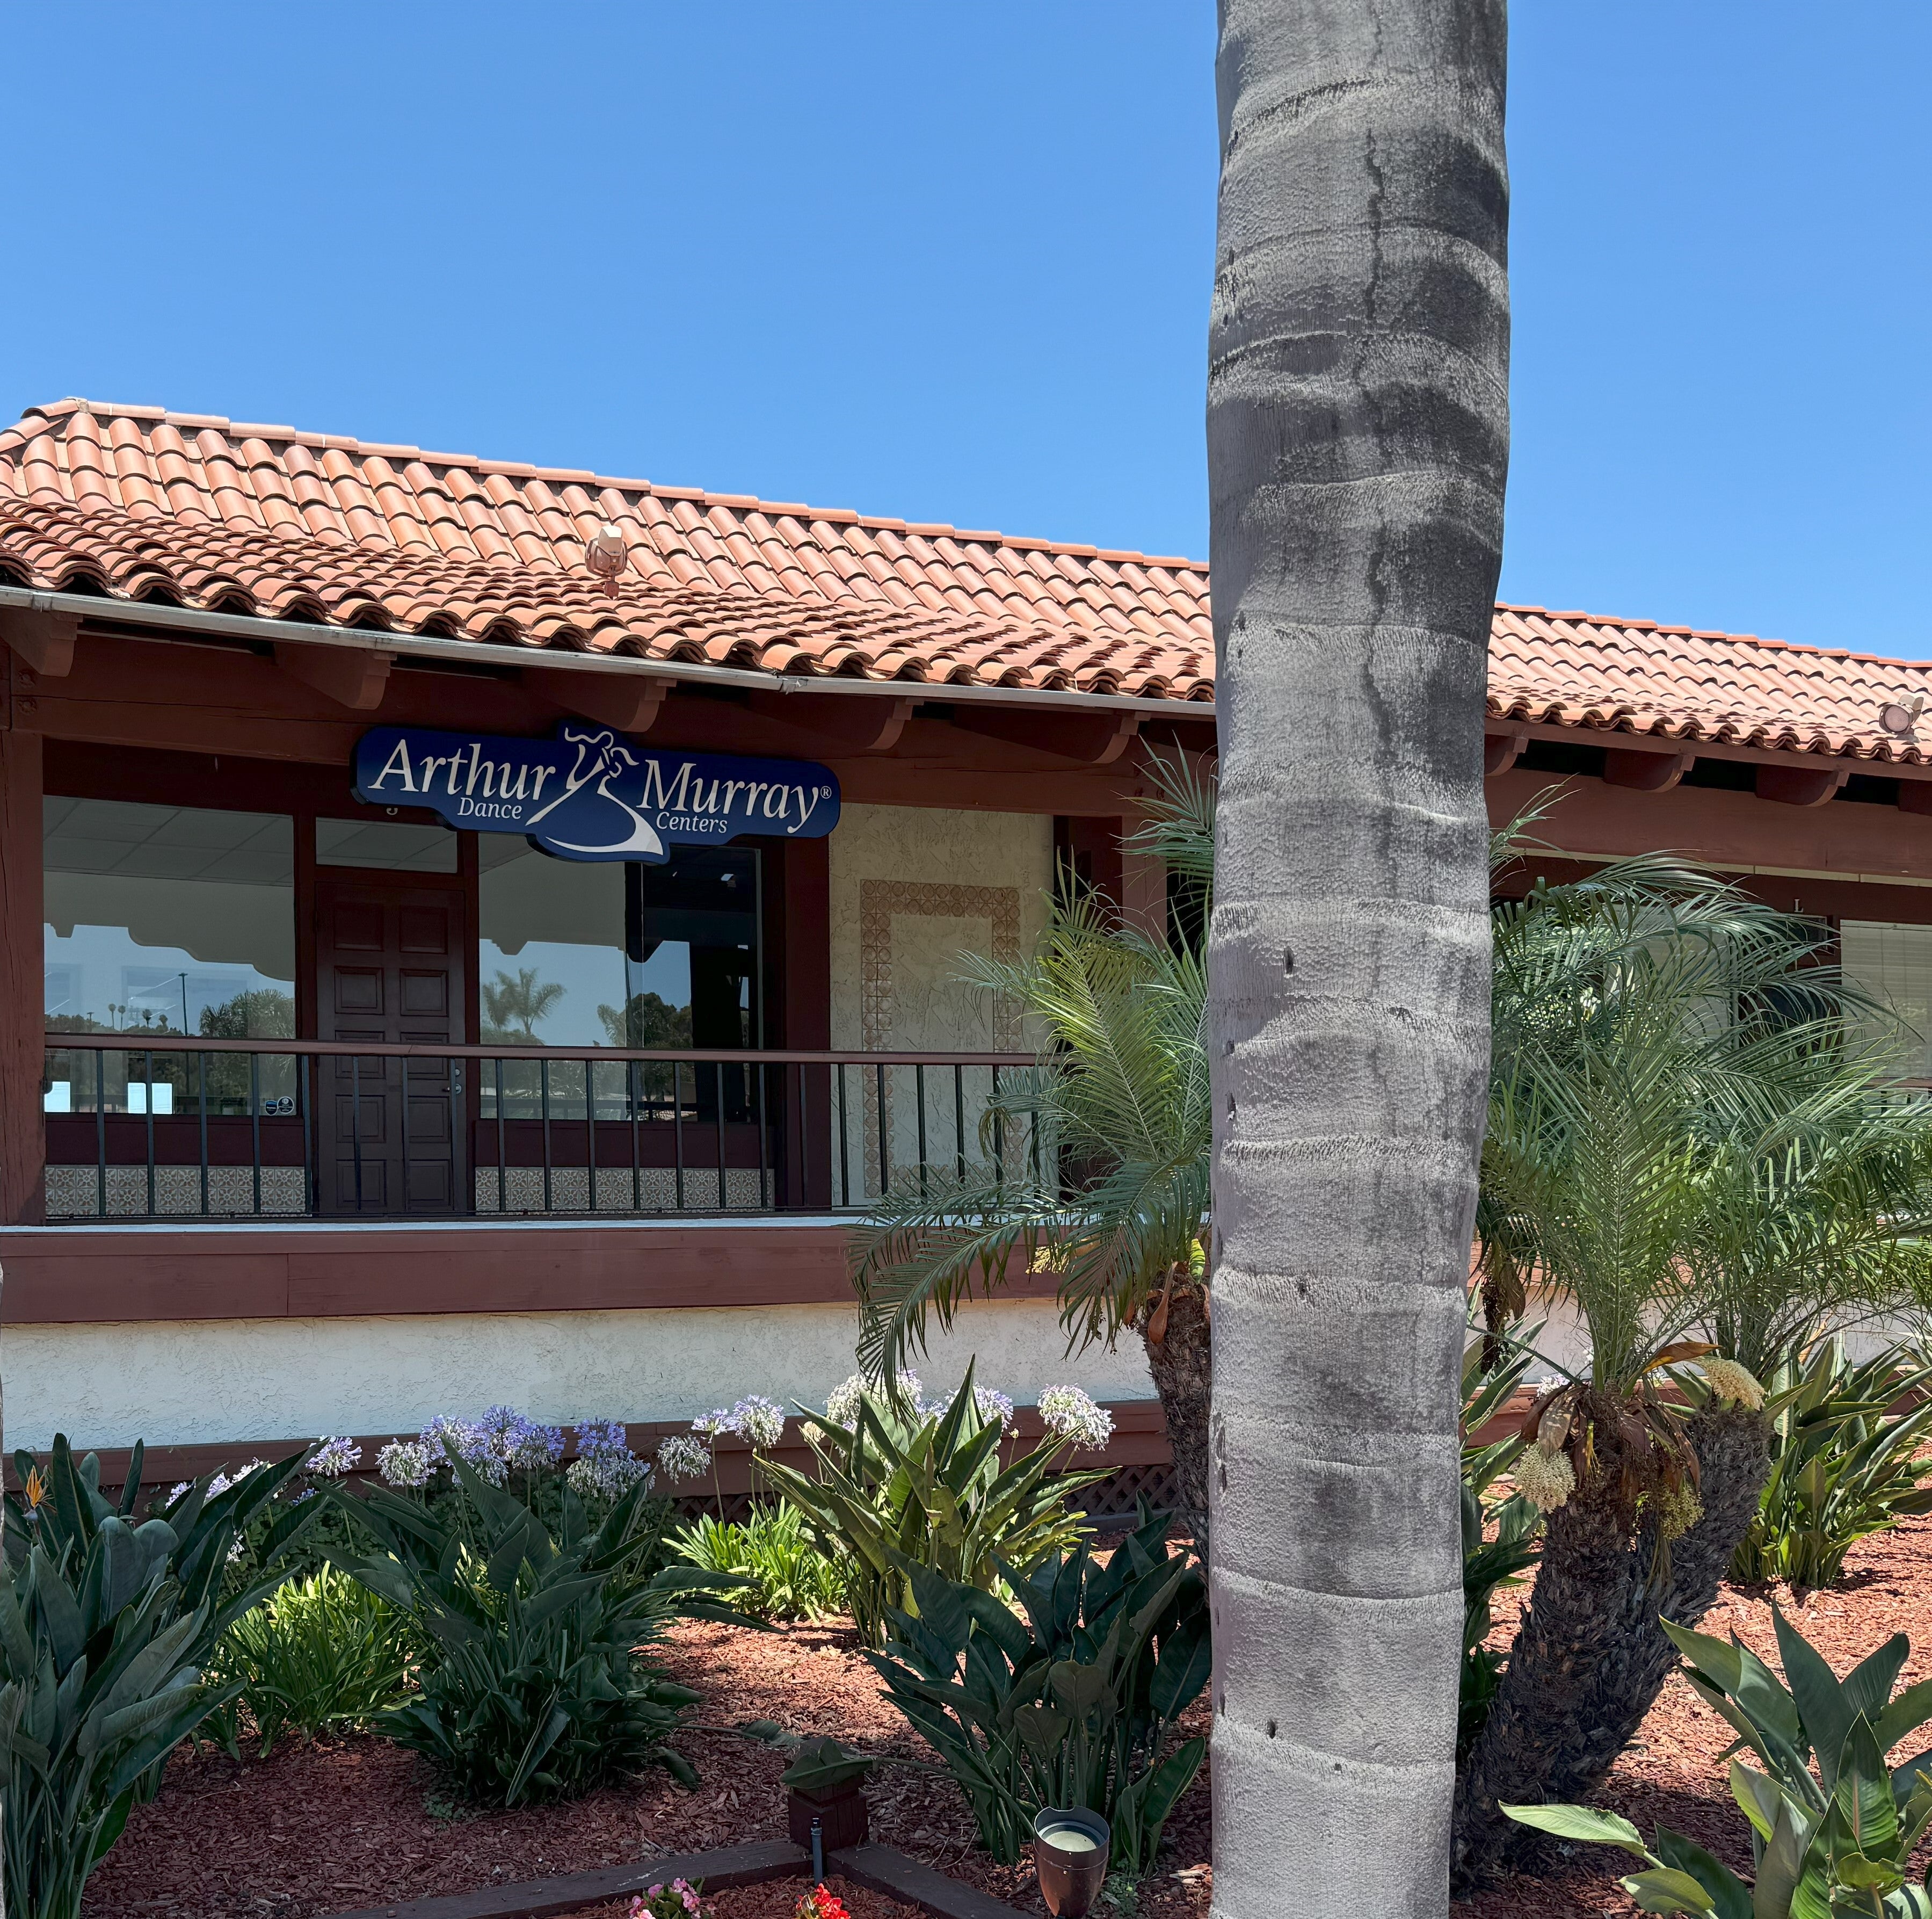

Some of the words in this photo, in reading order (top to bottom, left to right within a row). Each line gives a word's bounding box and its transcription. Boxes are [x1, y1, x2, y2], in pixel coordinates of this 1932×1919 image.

[367, 739, 556, 800] Arthur
[457, 797, 522, 820] Dance
[656, 812, 728, 834] Centers
[1794, 899, 1804, 913] L
